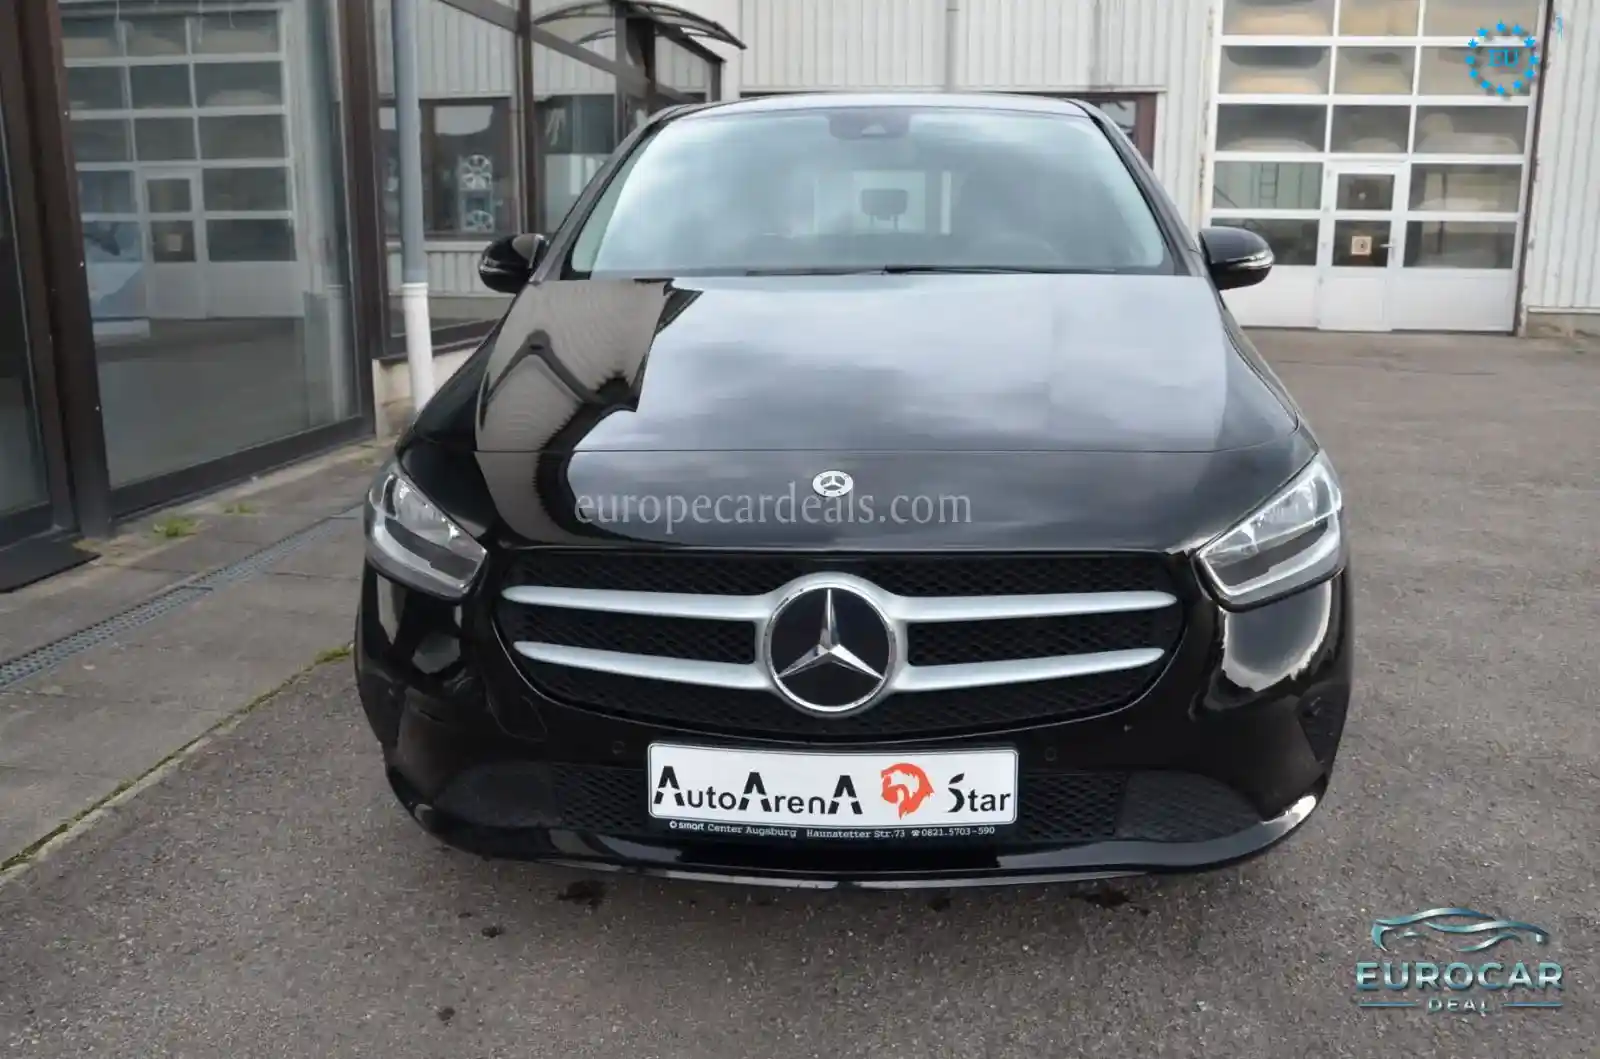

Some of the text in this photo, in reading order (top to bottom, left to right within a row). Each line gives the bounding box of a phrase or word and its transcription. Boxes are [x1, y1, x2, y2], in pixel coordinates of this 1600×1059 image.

[948, 773, 1011, 813] Star
[678, 821, 705, 831] smart
[707, 823, 742, 834] Center
[745, 826, 797, 838] Augsburg
[806, 828, 871, 840] Haunstetter
